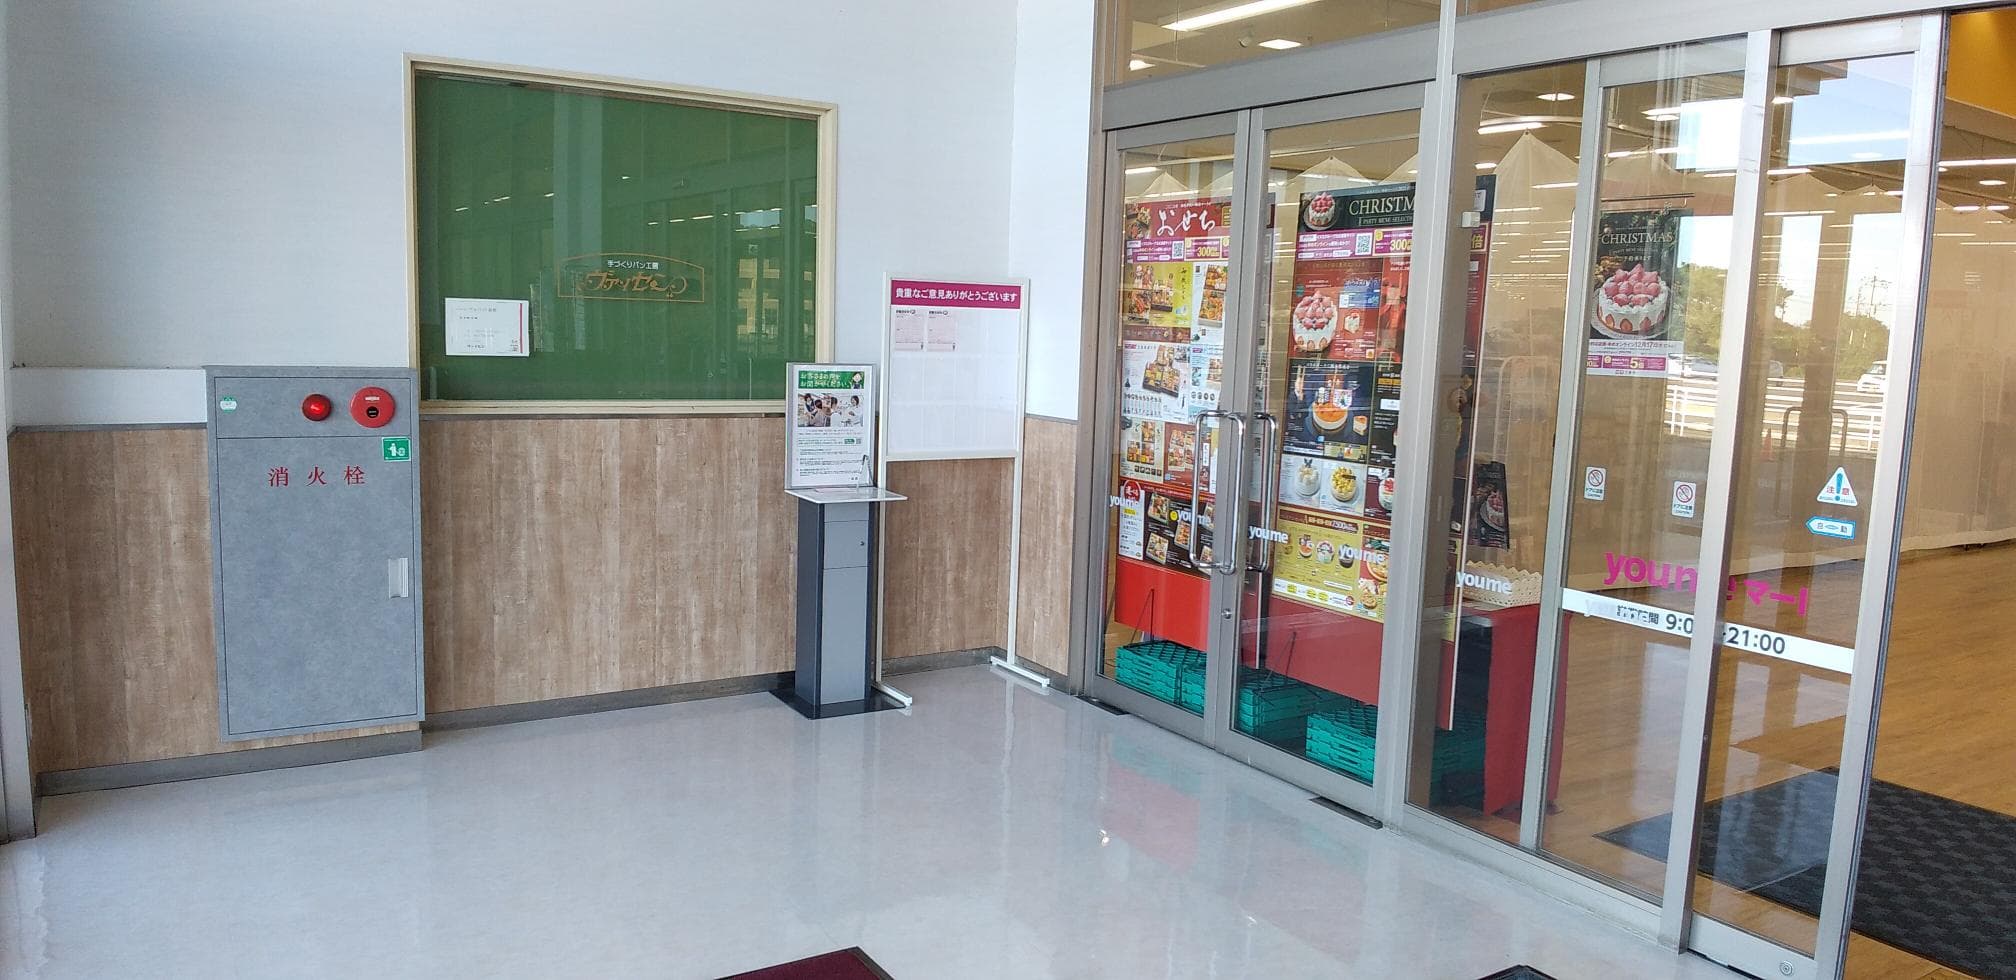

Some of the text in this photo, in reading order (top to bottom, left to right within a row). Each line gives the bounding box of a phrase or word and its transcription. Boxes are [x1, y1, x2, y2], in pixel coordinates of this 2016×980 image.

[1156, 208, 1216, 237] おせち
[1601, 231, 1674, 245] CHRISTMAS
[607, 259, 660, 271] 手づくりパン工房
[895, 286, 1019, 304] 貴重なご意見ありがとうございます
[267, 464, 366, 488] 消火栓
[1248, 524, 1289, 545] youme
[1338, 543, 1386, 565] youme
[1456, 570, 1513, 595] youme
